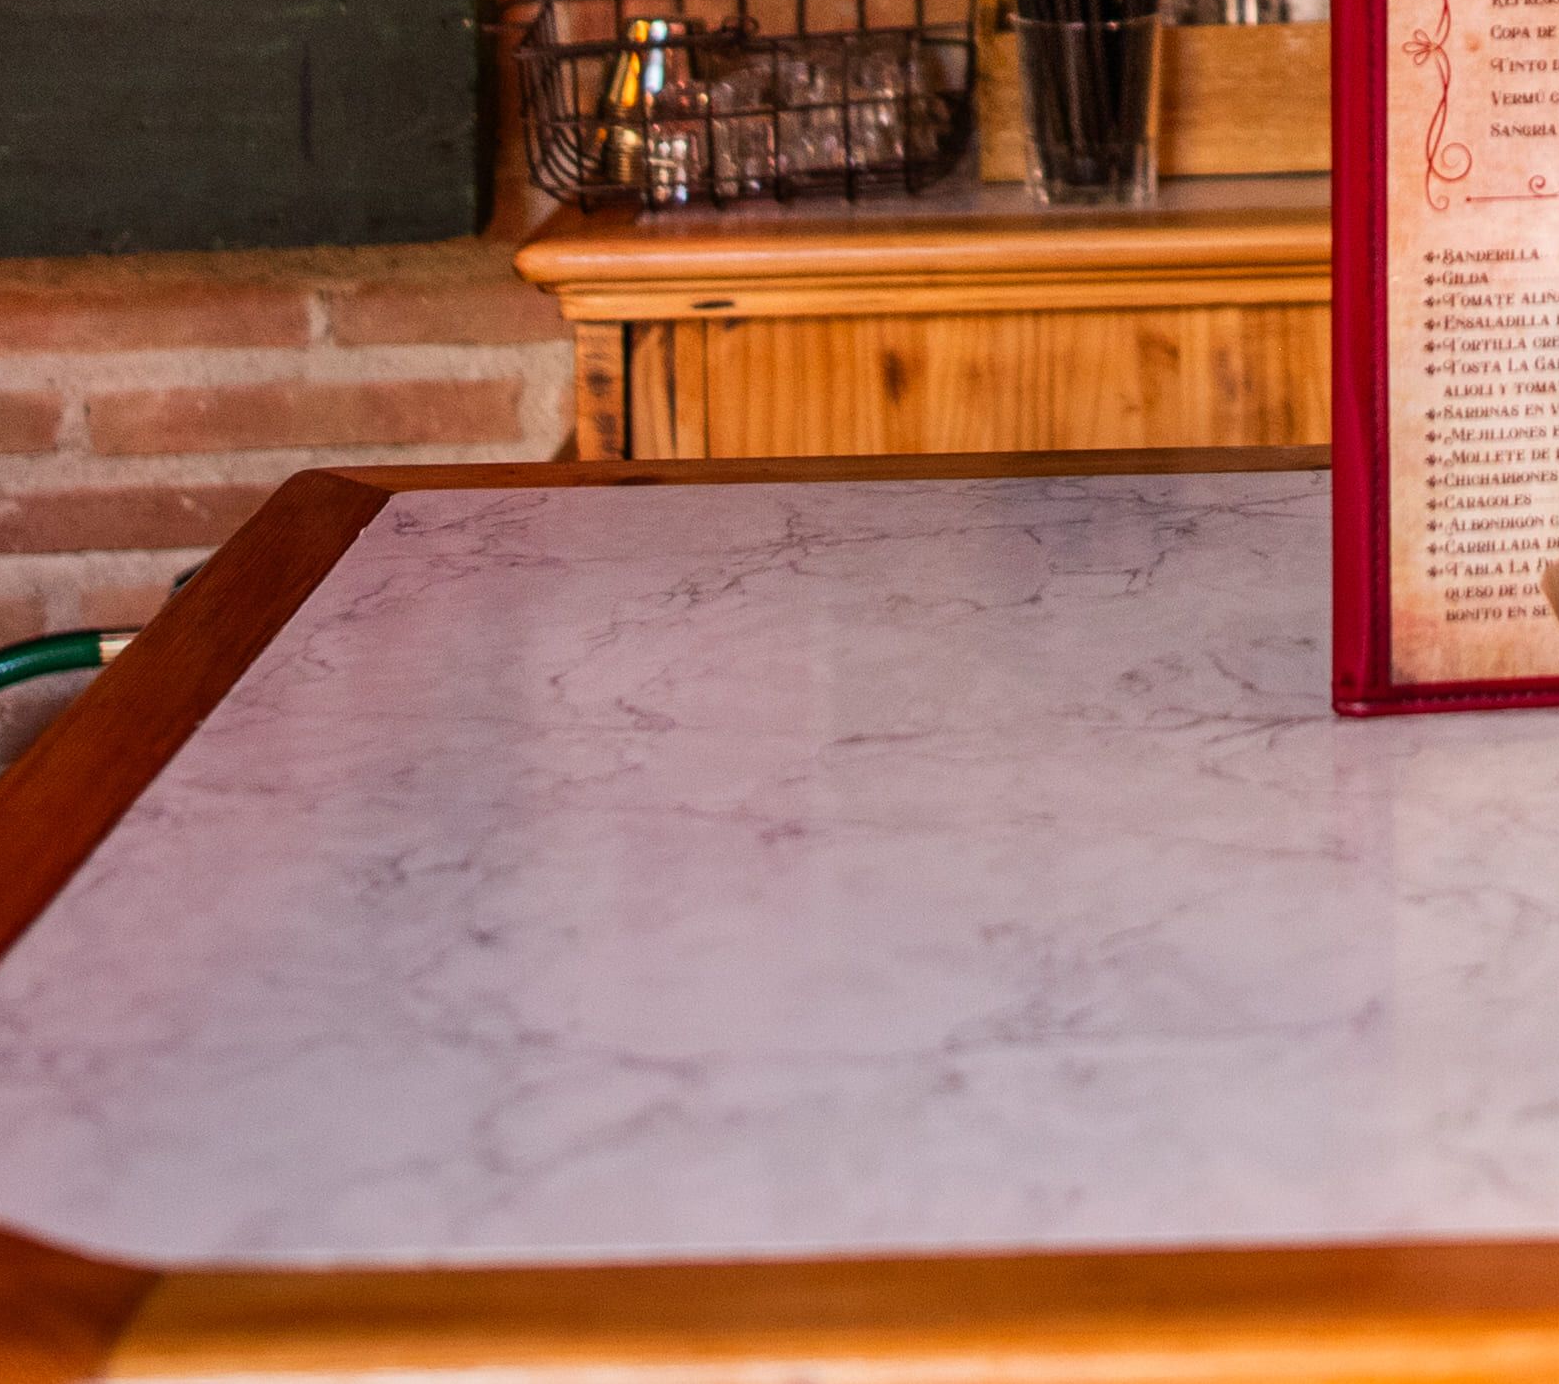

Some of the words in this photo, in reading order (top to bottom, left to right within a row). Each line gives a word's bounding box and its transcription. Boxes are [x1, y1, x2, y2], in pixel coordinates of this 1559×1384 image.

[1490, 25, 1530, 40] COPA
[1537, 25, 1556, 38] DE
[1490, 57, 1546, 73] TINTO
[1442, 248, 1540, 266] BANDERILLA
[1443, 271, 1489, 286] GILDA
[1443, 292, 1515, 309] TOMATE
[1444, 314, 1549, 331] ENSALADILLA
[1443, 336, 1526, 352] TORTILLA
[1443, 359, 1502, 375] TOSTA
[1508, 357, 1529, 373] LA
[1443, 403, 1520, 420] SARDINAS
[1525, 403, 1544, 416] EN
[1444, 425, 1547, 445] MEJILLONES
[1443, 448, 1525, 467] MOLLETE
[1531, 447, 1549, 460] DE
[1444, 469, 1558, 487] CHICHARRONES
[1444, 537, 1540, 554] CARRILLADA
[1445, 560, 1503, 577] TABLA
[1508, 558, 1531, 574] LA
[1444, 585, 1494, 603] QUESO
[1498, 584, 1517, 597] DE
[1445, 606, 1503, 622] BONITO
[1507, 605, 1527, 617] EN
